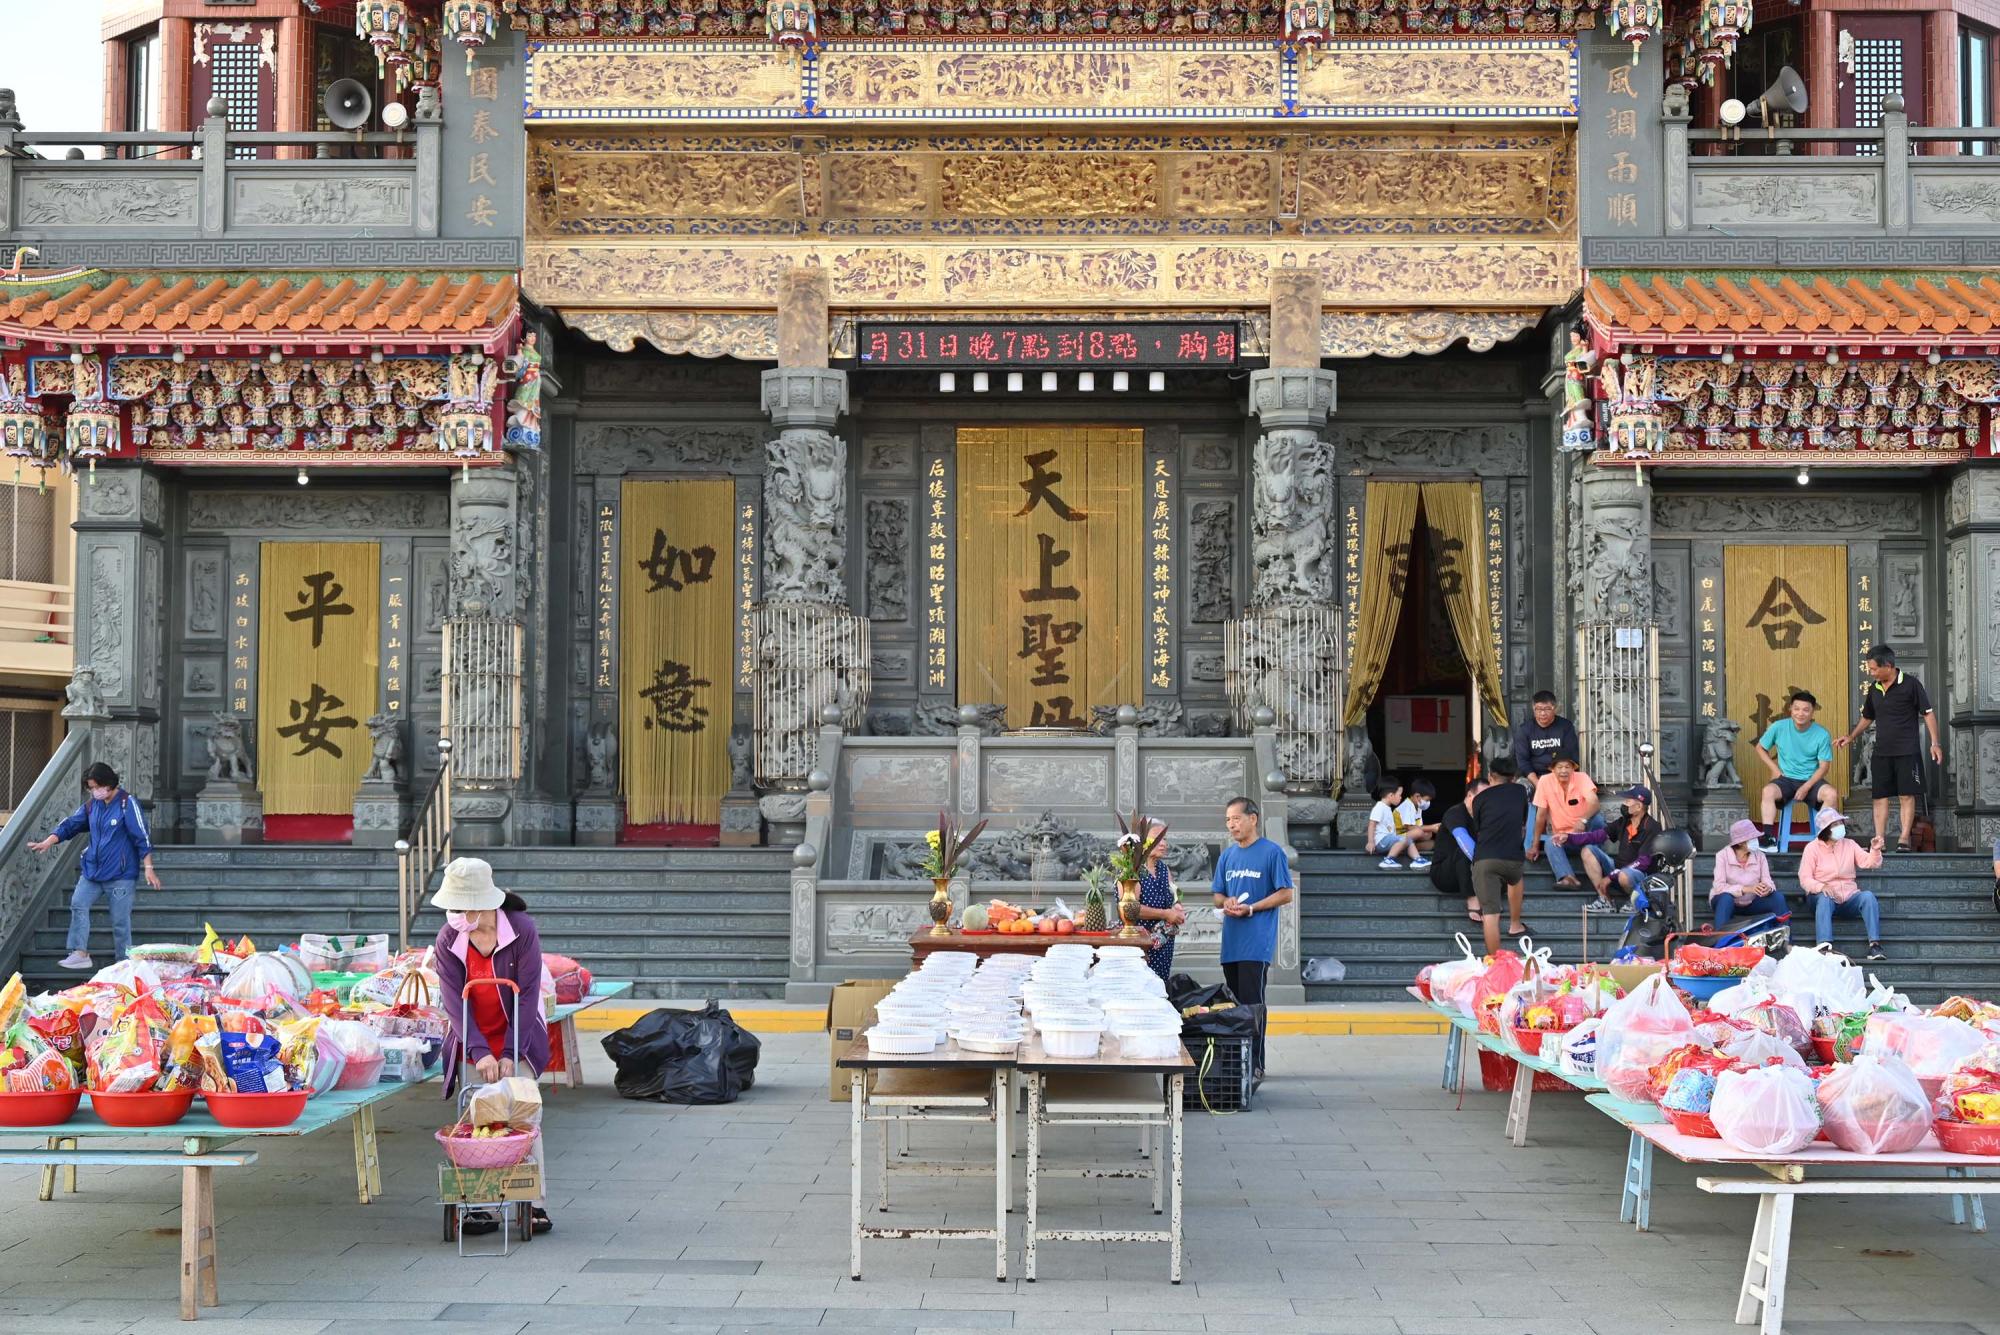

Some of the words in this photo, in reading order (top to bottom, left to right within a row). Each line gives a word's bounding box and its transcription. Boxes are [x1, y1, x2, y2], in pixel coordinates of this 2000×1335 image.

[466, 67, 499, 227] 國泰民安
[1606, 65, 1638, 227] 風調雨順
[277, 571, 359, 759] 平安
[638, 528, 717, 733] 如意
